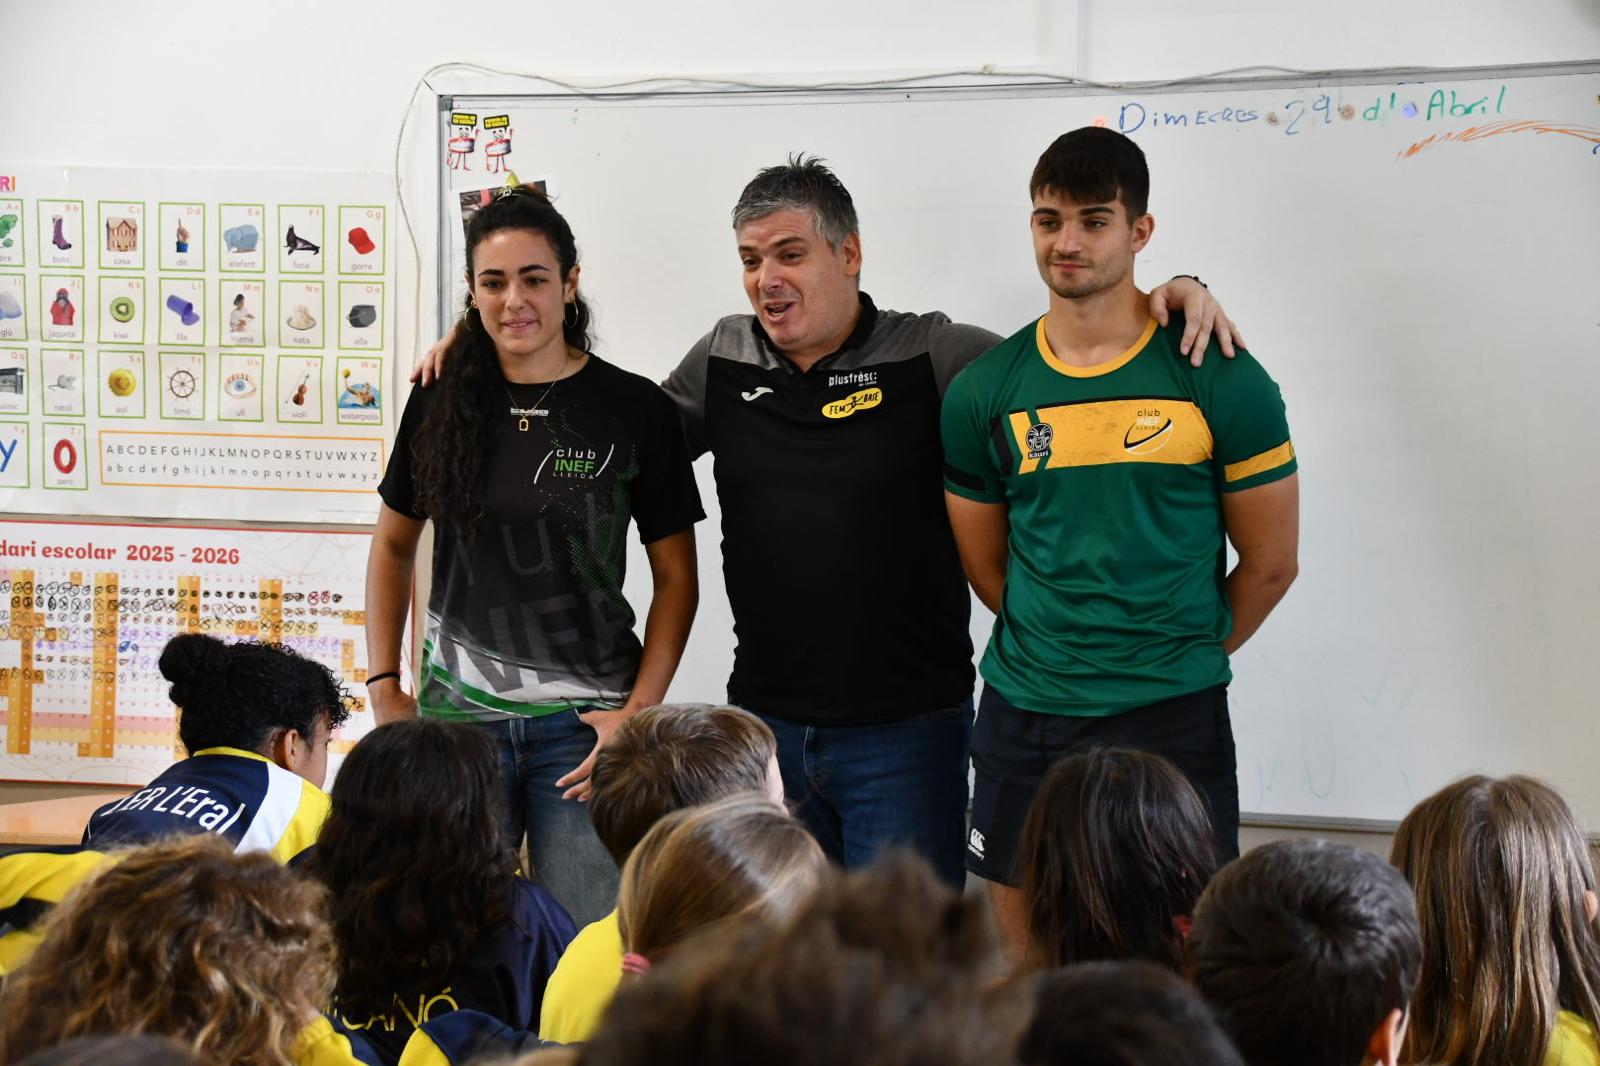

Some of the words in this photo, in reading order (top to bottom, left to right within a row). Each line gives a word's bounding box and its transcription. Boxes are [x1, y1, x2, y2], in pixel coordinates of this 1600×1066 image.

[1285, 94, 1332, 136] 29
[1426, 85, 1506, 121] Abril
[229, 260, 255, 268] elefant
[292, 261, 310, 269] foca
[830, 405, 846, 415] FEM
[864, 391, 880, 403] BASE
[341, 412, 379, 421] waterpolo
[1137, 409, 1160, 417] club
[556, 447, 596, 459] club
[554, 459, 595, 473] INEF
[0, 540, 36, 557] dari
[41, 543, 117, 560] escolar
[126, 545, 174, 562] 2025
[192, 547, 240, 565] 2026
